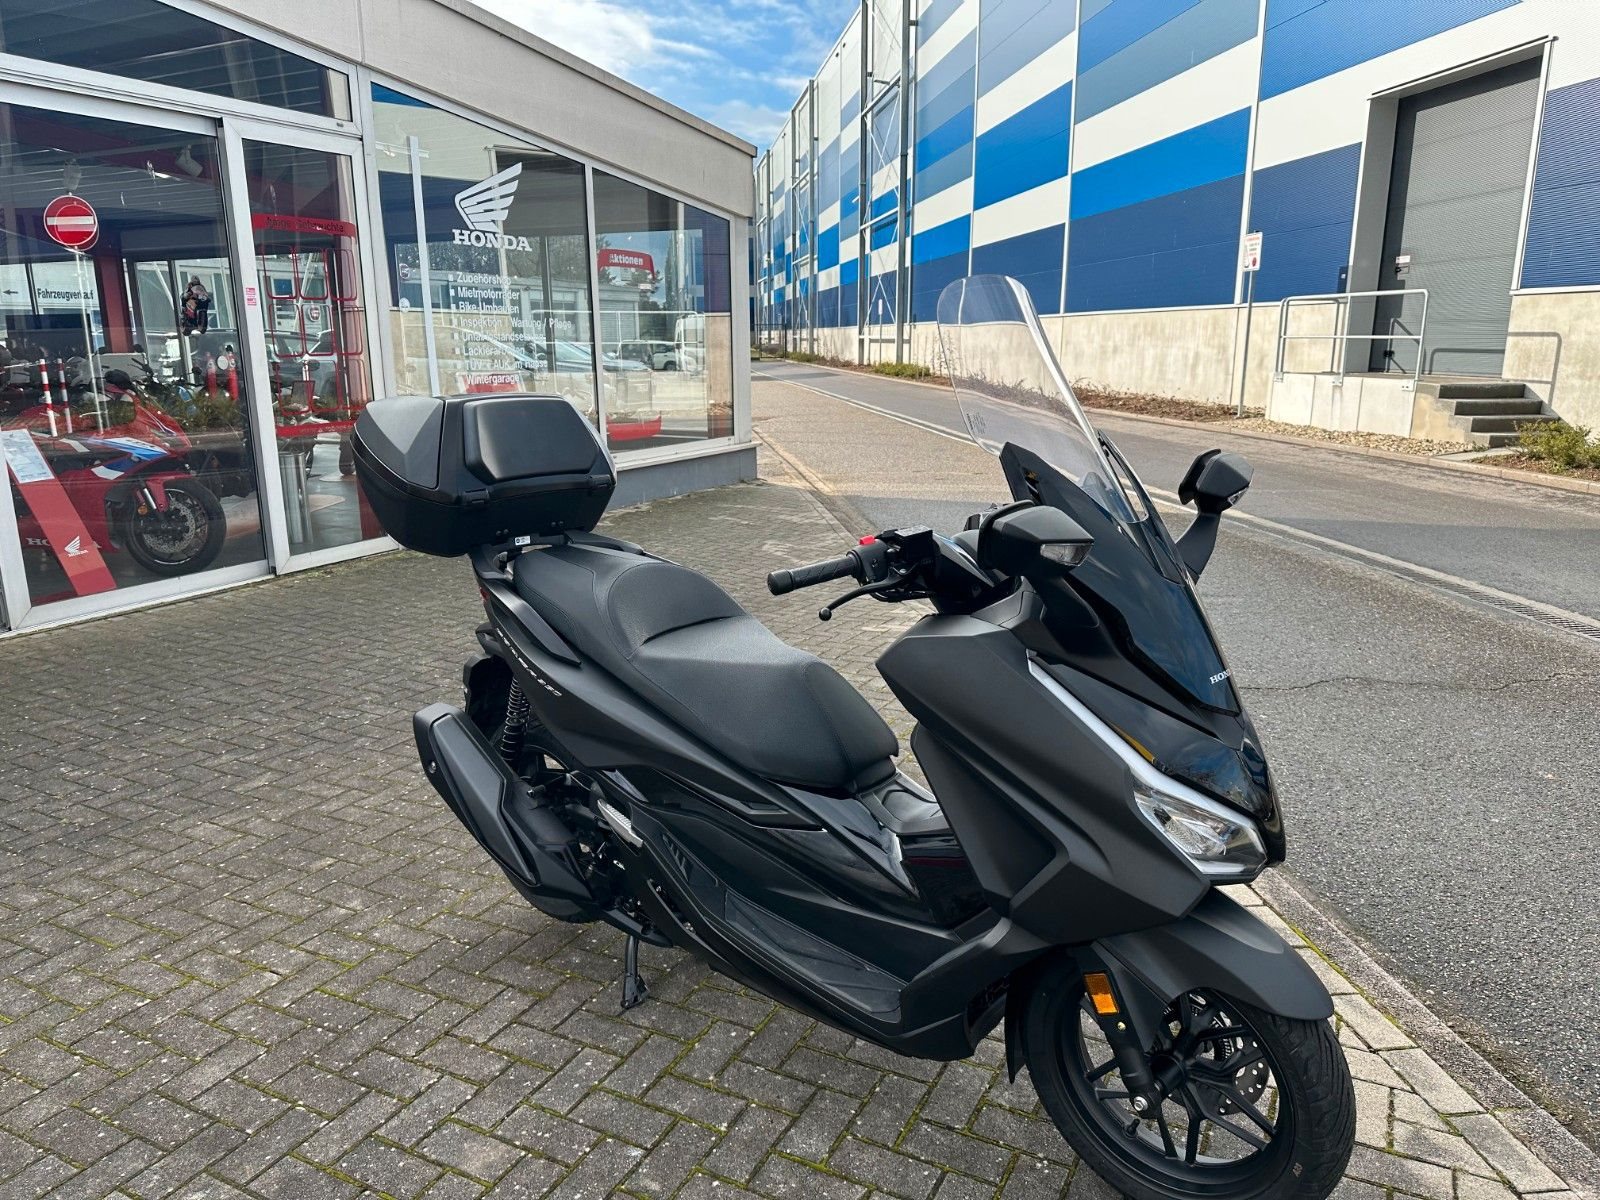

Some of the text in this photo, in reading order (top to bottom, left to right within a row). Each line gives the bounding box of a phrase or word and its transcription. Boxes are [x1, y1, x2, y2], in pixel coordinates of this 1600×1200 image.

[452, 229, 532, 251] HONDA
[608, 253, 643, 265] Aktionen
[458, 286, 519, 300] Mietmotorräder
[460, 317, 503, 329] Inspektion
[512, 318, 541, 330] Wartung
[549, 318, 572, 330] Pflege
[463, 345, 525, 356] Lackierarben
[467, 374, 520, 386] Wintergarage
